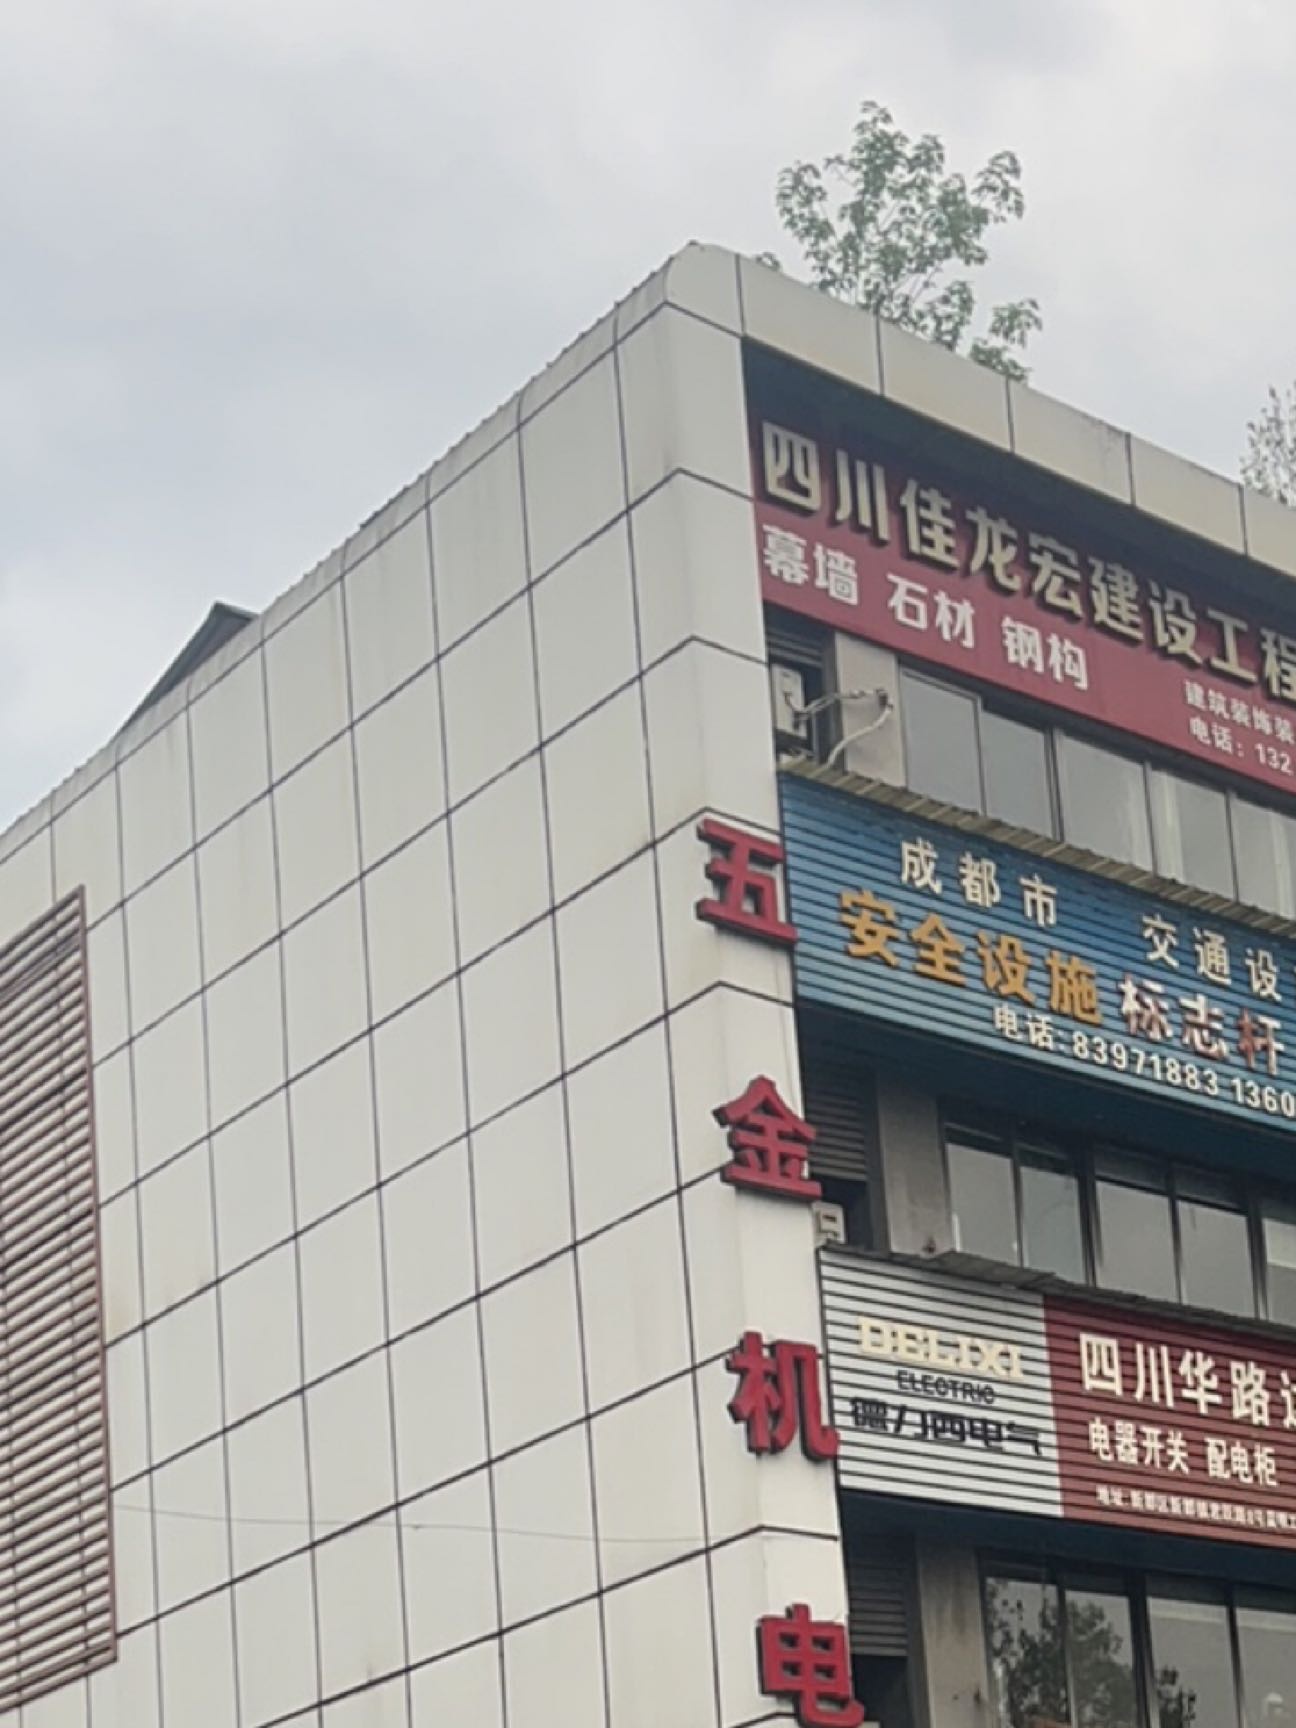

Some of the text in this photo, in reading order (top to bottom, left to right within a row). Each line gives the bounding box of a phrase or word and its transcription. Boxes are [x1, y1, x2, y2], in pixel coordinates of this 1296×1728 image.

[762, 525, 1090, 692] 幕墙 石材 钢构
[697, 818, 865, 1728] 五金机电
[857, 1316, 1024, 1381] DELIXI
[897, 1369, 997, 1405] ELECTRIC
[1088, 1416, 1190, 1475] 电器开关
[1204, 1436, 1279, 1486] 配电柜
